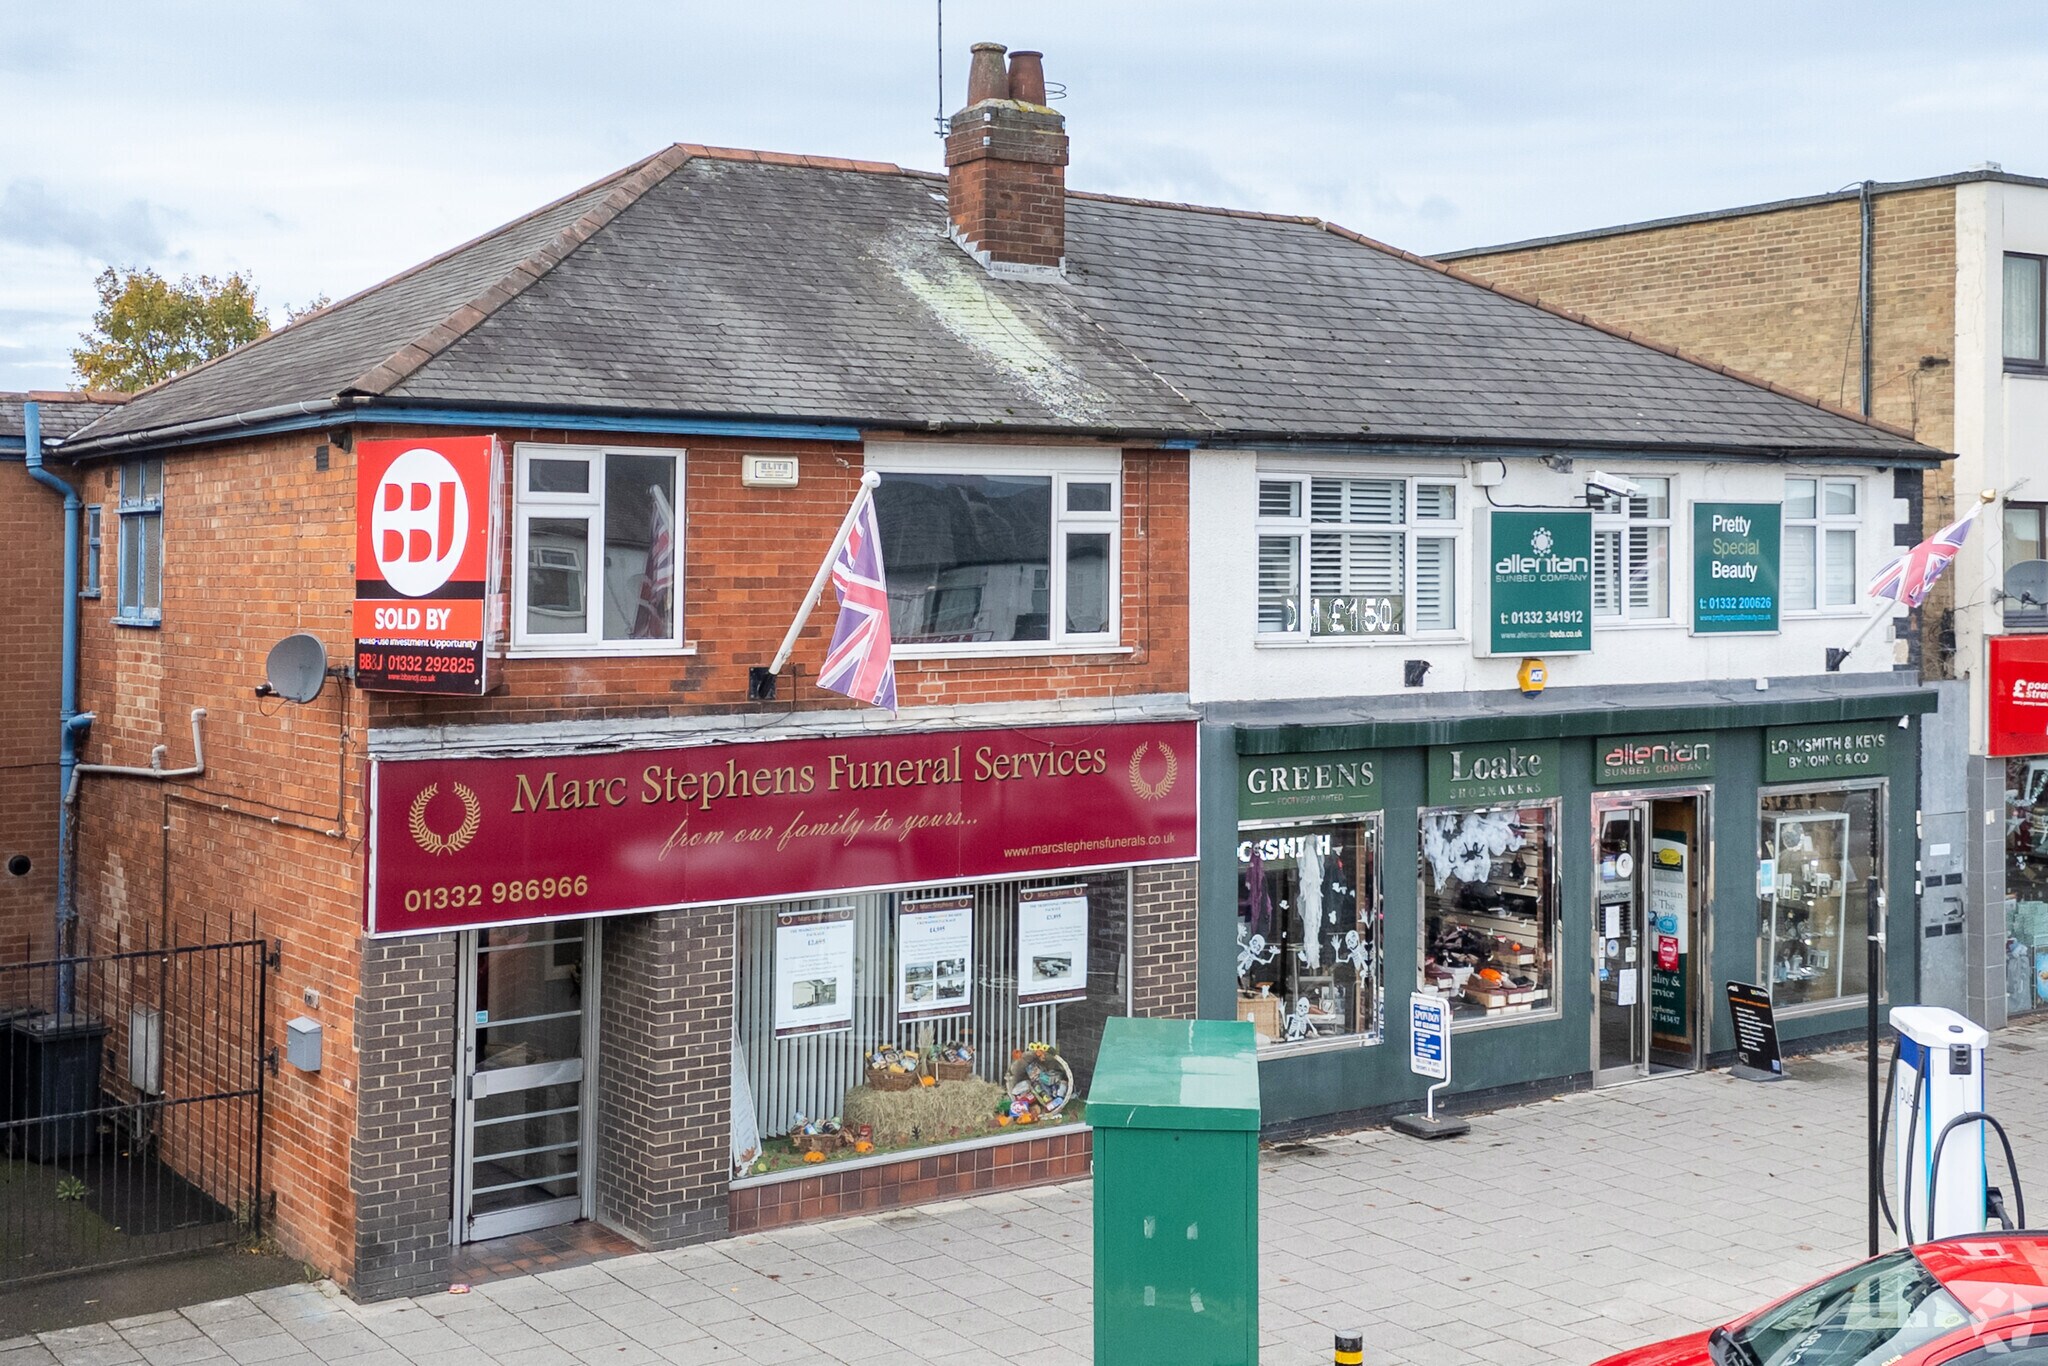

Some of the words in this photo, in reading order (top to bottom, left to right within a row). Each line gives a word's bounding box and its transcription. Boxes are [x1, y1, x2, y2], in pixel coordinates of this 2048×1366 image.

[1712, 515, 1751, 537] Pretty
[1712, 538, 1760, 558] Special
[1496, 554, 1588, 574] allentan
[1711, 561, 1757, 582] Beauty
[1495, 574, 1537, 582] SUNBED
[1540, 574, 1587, 582] COMPANY
[1709, 597, 1736, 609] 01332
[1739, 597, 1771, 609] 200626
[374, 608, 421, 630] SOLD
[426, 608, 451, 630] BY
[1511, 611, 1543, 624] 01332
[1545, 610, 1583, 623] 341912
[430, 639, 478, 651] Opportunity
[359, 653, 382, 671] BB&J
[388, 655, 422, 671] 01332
[425, 656, 475, 673] 292825
[1605, 741, 1711, 766] allentan
[1771, 737, 1841, 754] LOCKSMITH
[1844, 736, 1853, 750] &
[1856, 734, 1886, 748] KEYS
[1450, 747, 1542, 782] Loake
[1788, 757, 1801, 768] BY
[1835, 754, 1842, 765] G
[1844, 753, 1852, 764] &
[1854, 753, 1869, 764] CO
[511, 771, 627, 812] Marc
[642, 759, 815, 811] Stephens
[828, 745, 962, 791] Funeral
[974, 746, 1107, 782] Services
[1247, 762, 1374, 794] GREENS
[1604, 767, 1650, 777] SUNBED
[1449, 783, 1541, 800] SHOEMAKERS
[659, 819, 724, 861] from
[733, 829, 775, 843] our
[776, 808, 866, 852] family
[871, 809, 894, 831] to
[1003, 831, 1176, 859] www.marcstephensfunerals.co.uk
[1238, 834, 1331, 863] CKSMIH
[404, 884, 483, 912] 01332
[491, 875, 588, 904] 986966
[1652, 973, 1669, 986] ality
[1671, 976, 1680, 987] &
